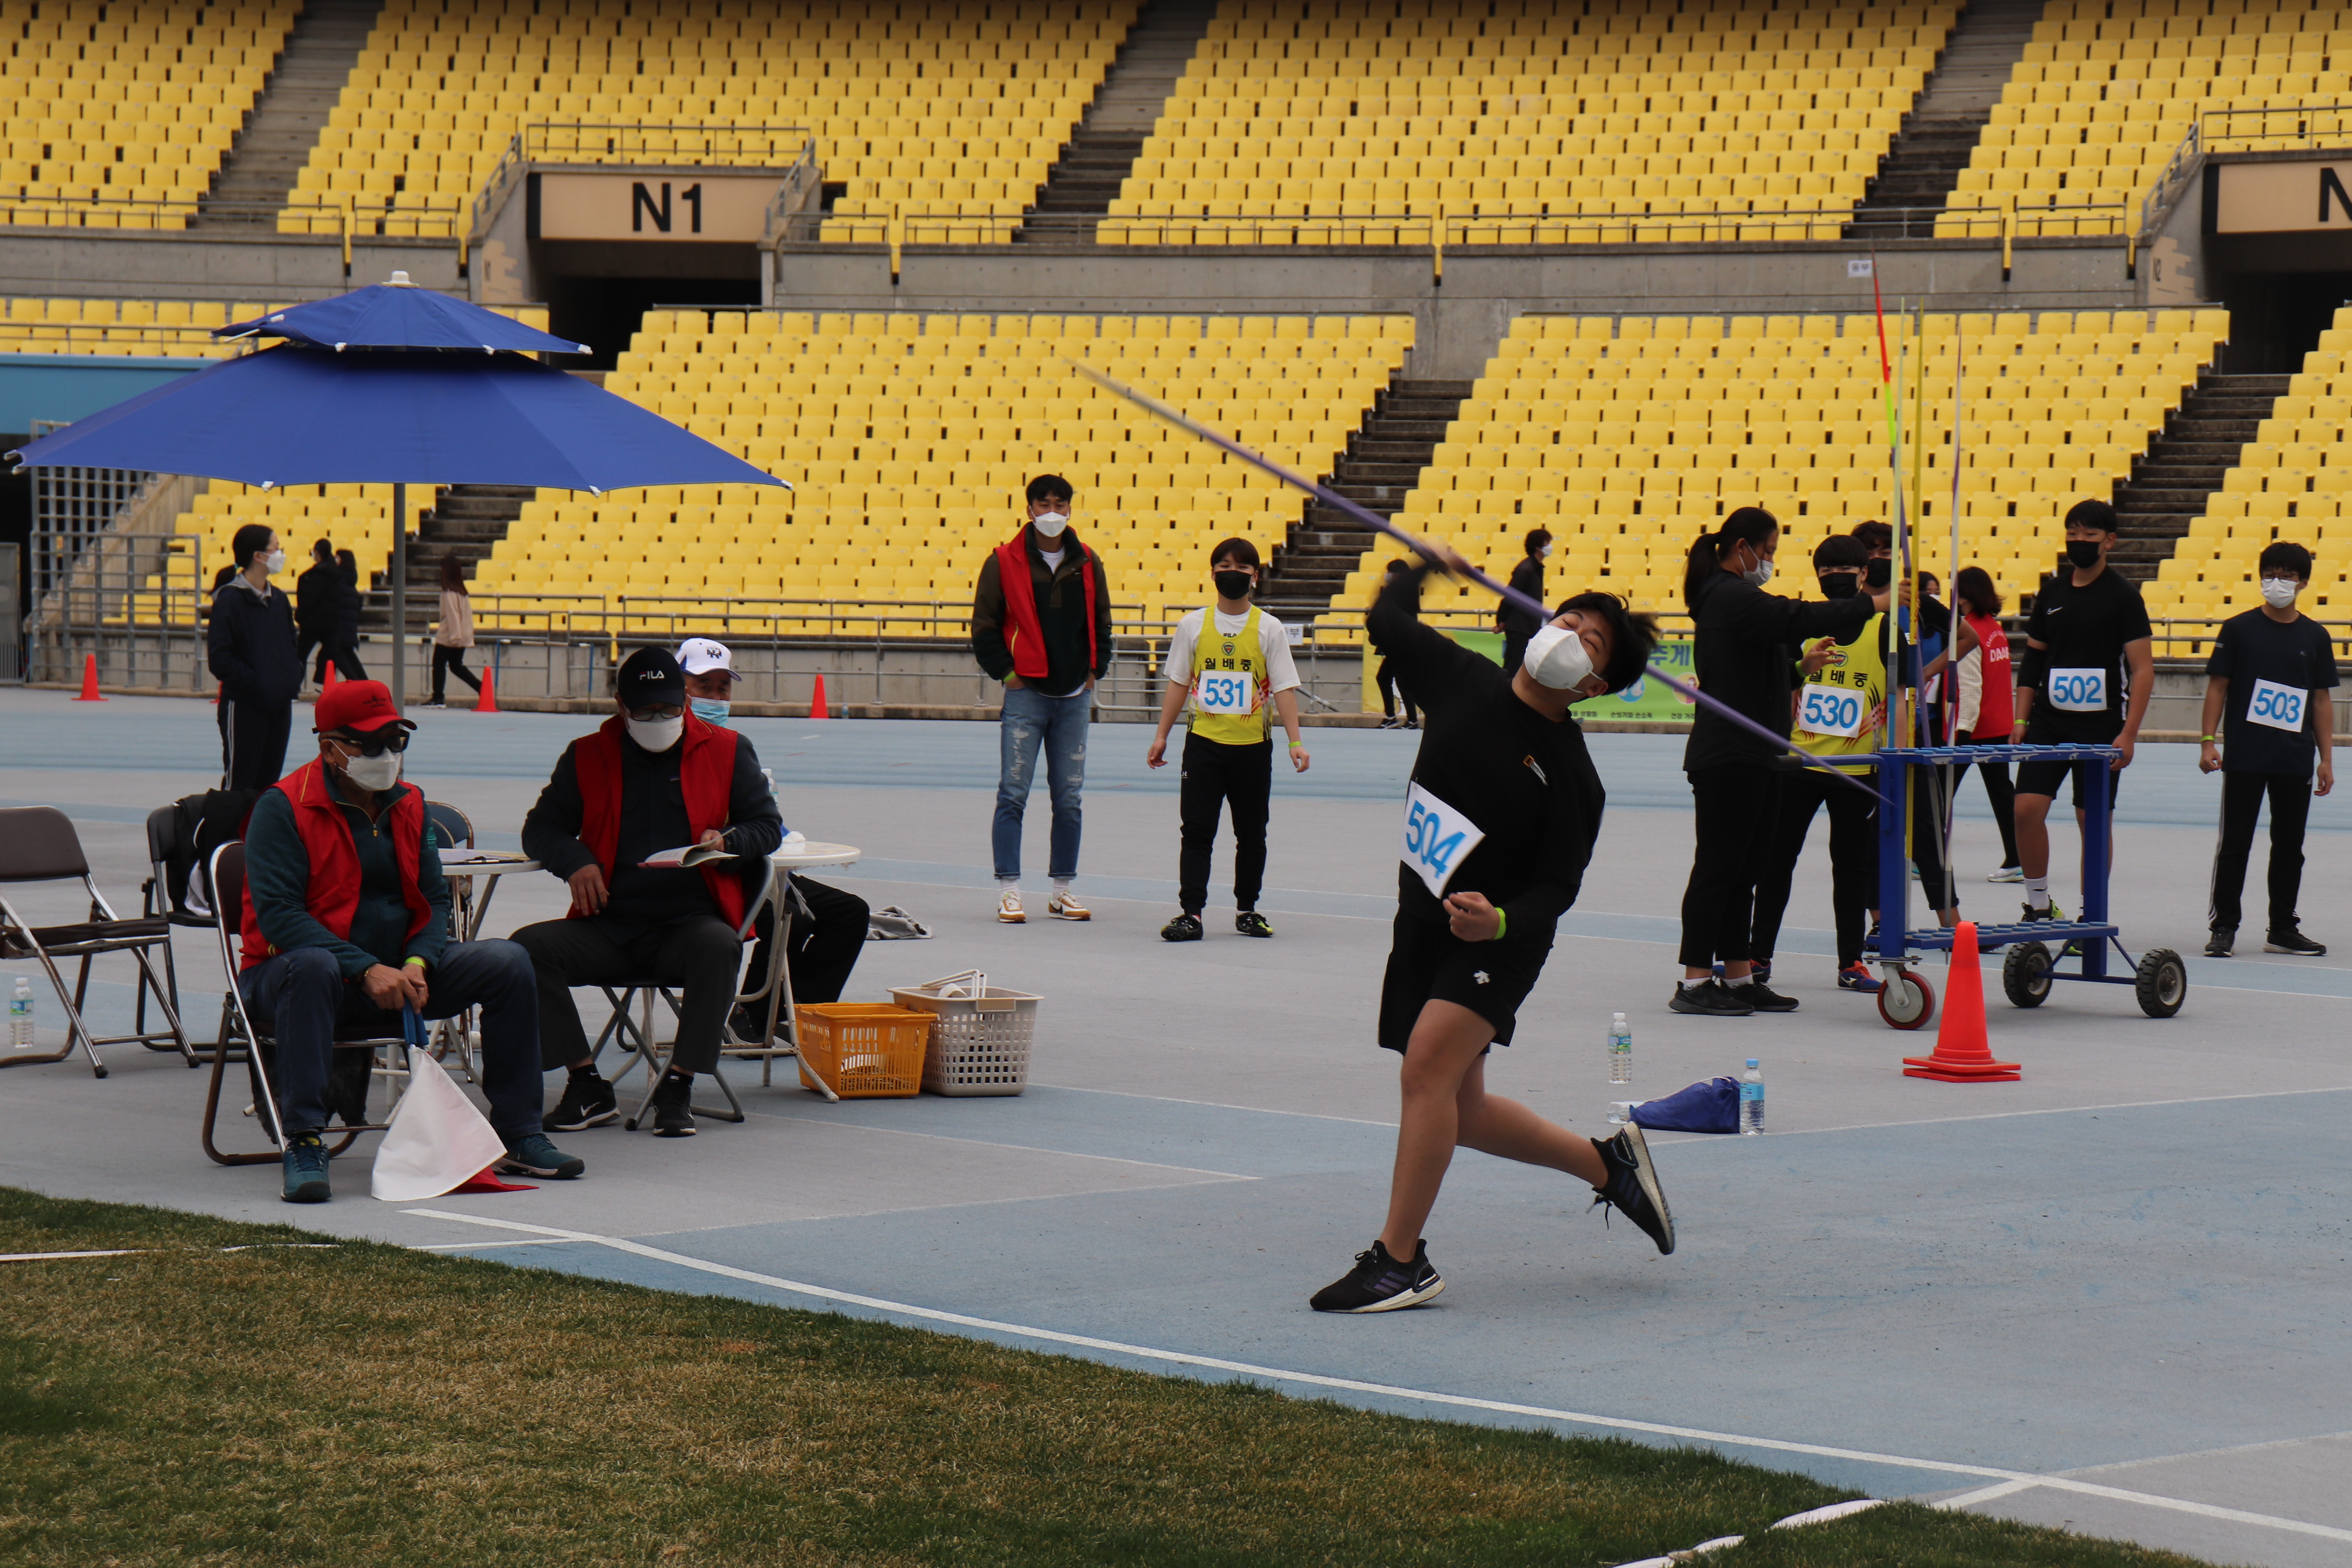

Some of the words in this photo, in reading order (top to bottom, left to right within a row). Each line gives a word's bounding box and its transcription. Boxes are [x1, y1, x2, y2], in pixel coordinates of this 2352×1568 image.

[632, 182, 701, 233] N1
[639, 670, 665, 680] FILA
[1205, 657, 1252, 671] 월배중
[1204, 679, 1244, 707] 531
[2053, 675, 2102, 704] 502
[2254, 688, 2301, 723] 503
[1804, 693, 1858, 729] 530
[1406, 799, 1468, 880] 504
